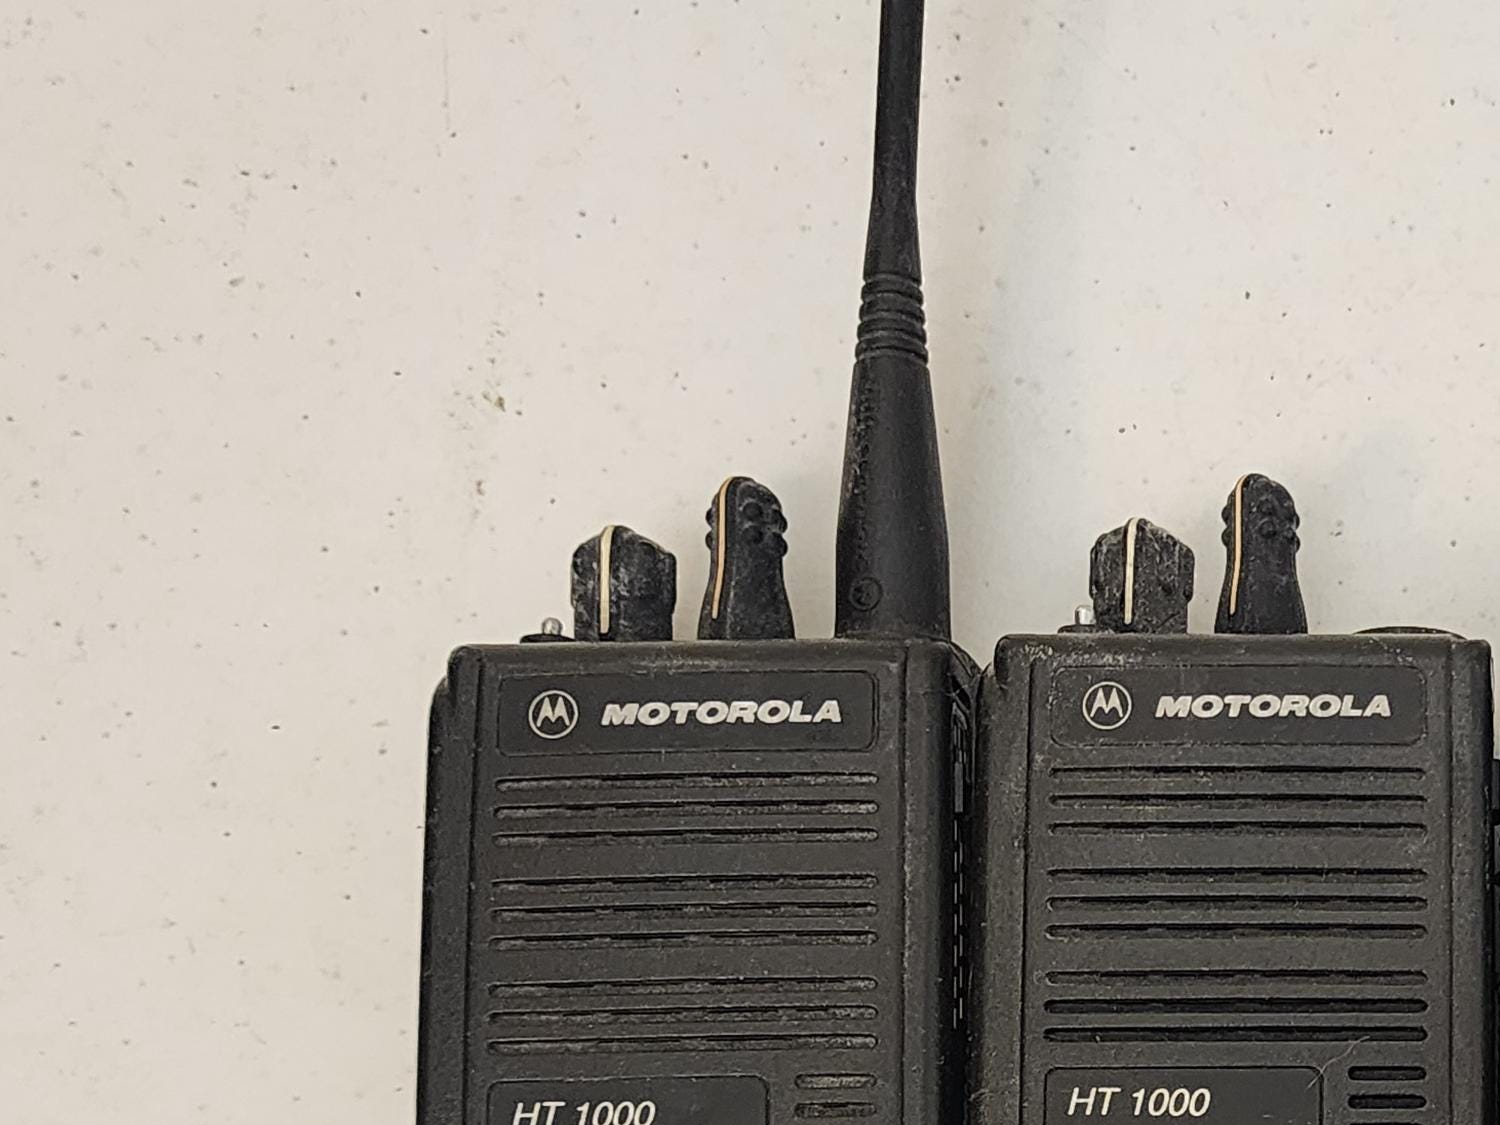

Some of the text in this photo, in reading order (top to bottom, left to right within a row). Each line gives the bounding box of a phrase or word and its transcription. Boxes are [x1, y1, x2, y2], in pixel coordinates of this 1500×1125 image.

[601, 699, 842, 726] MOTOROLA
[1154, 693, 1391, 719] MOTOROLA
[1067, 1086, 1211, 1117] HT 1000
